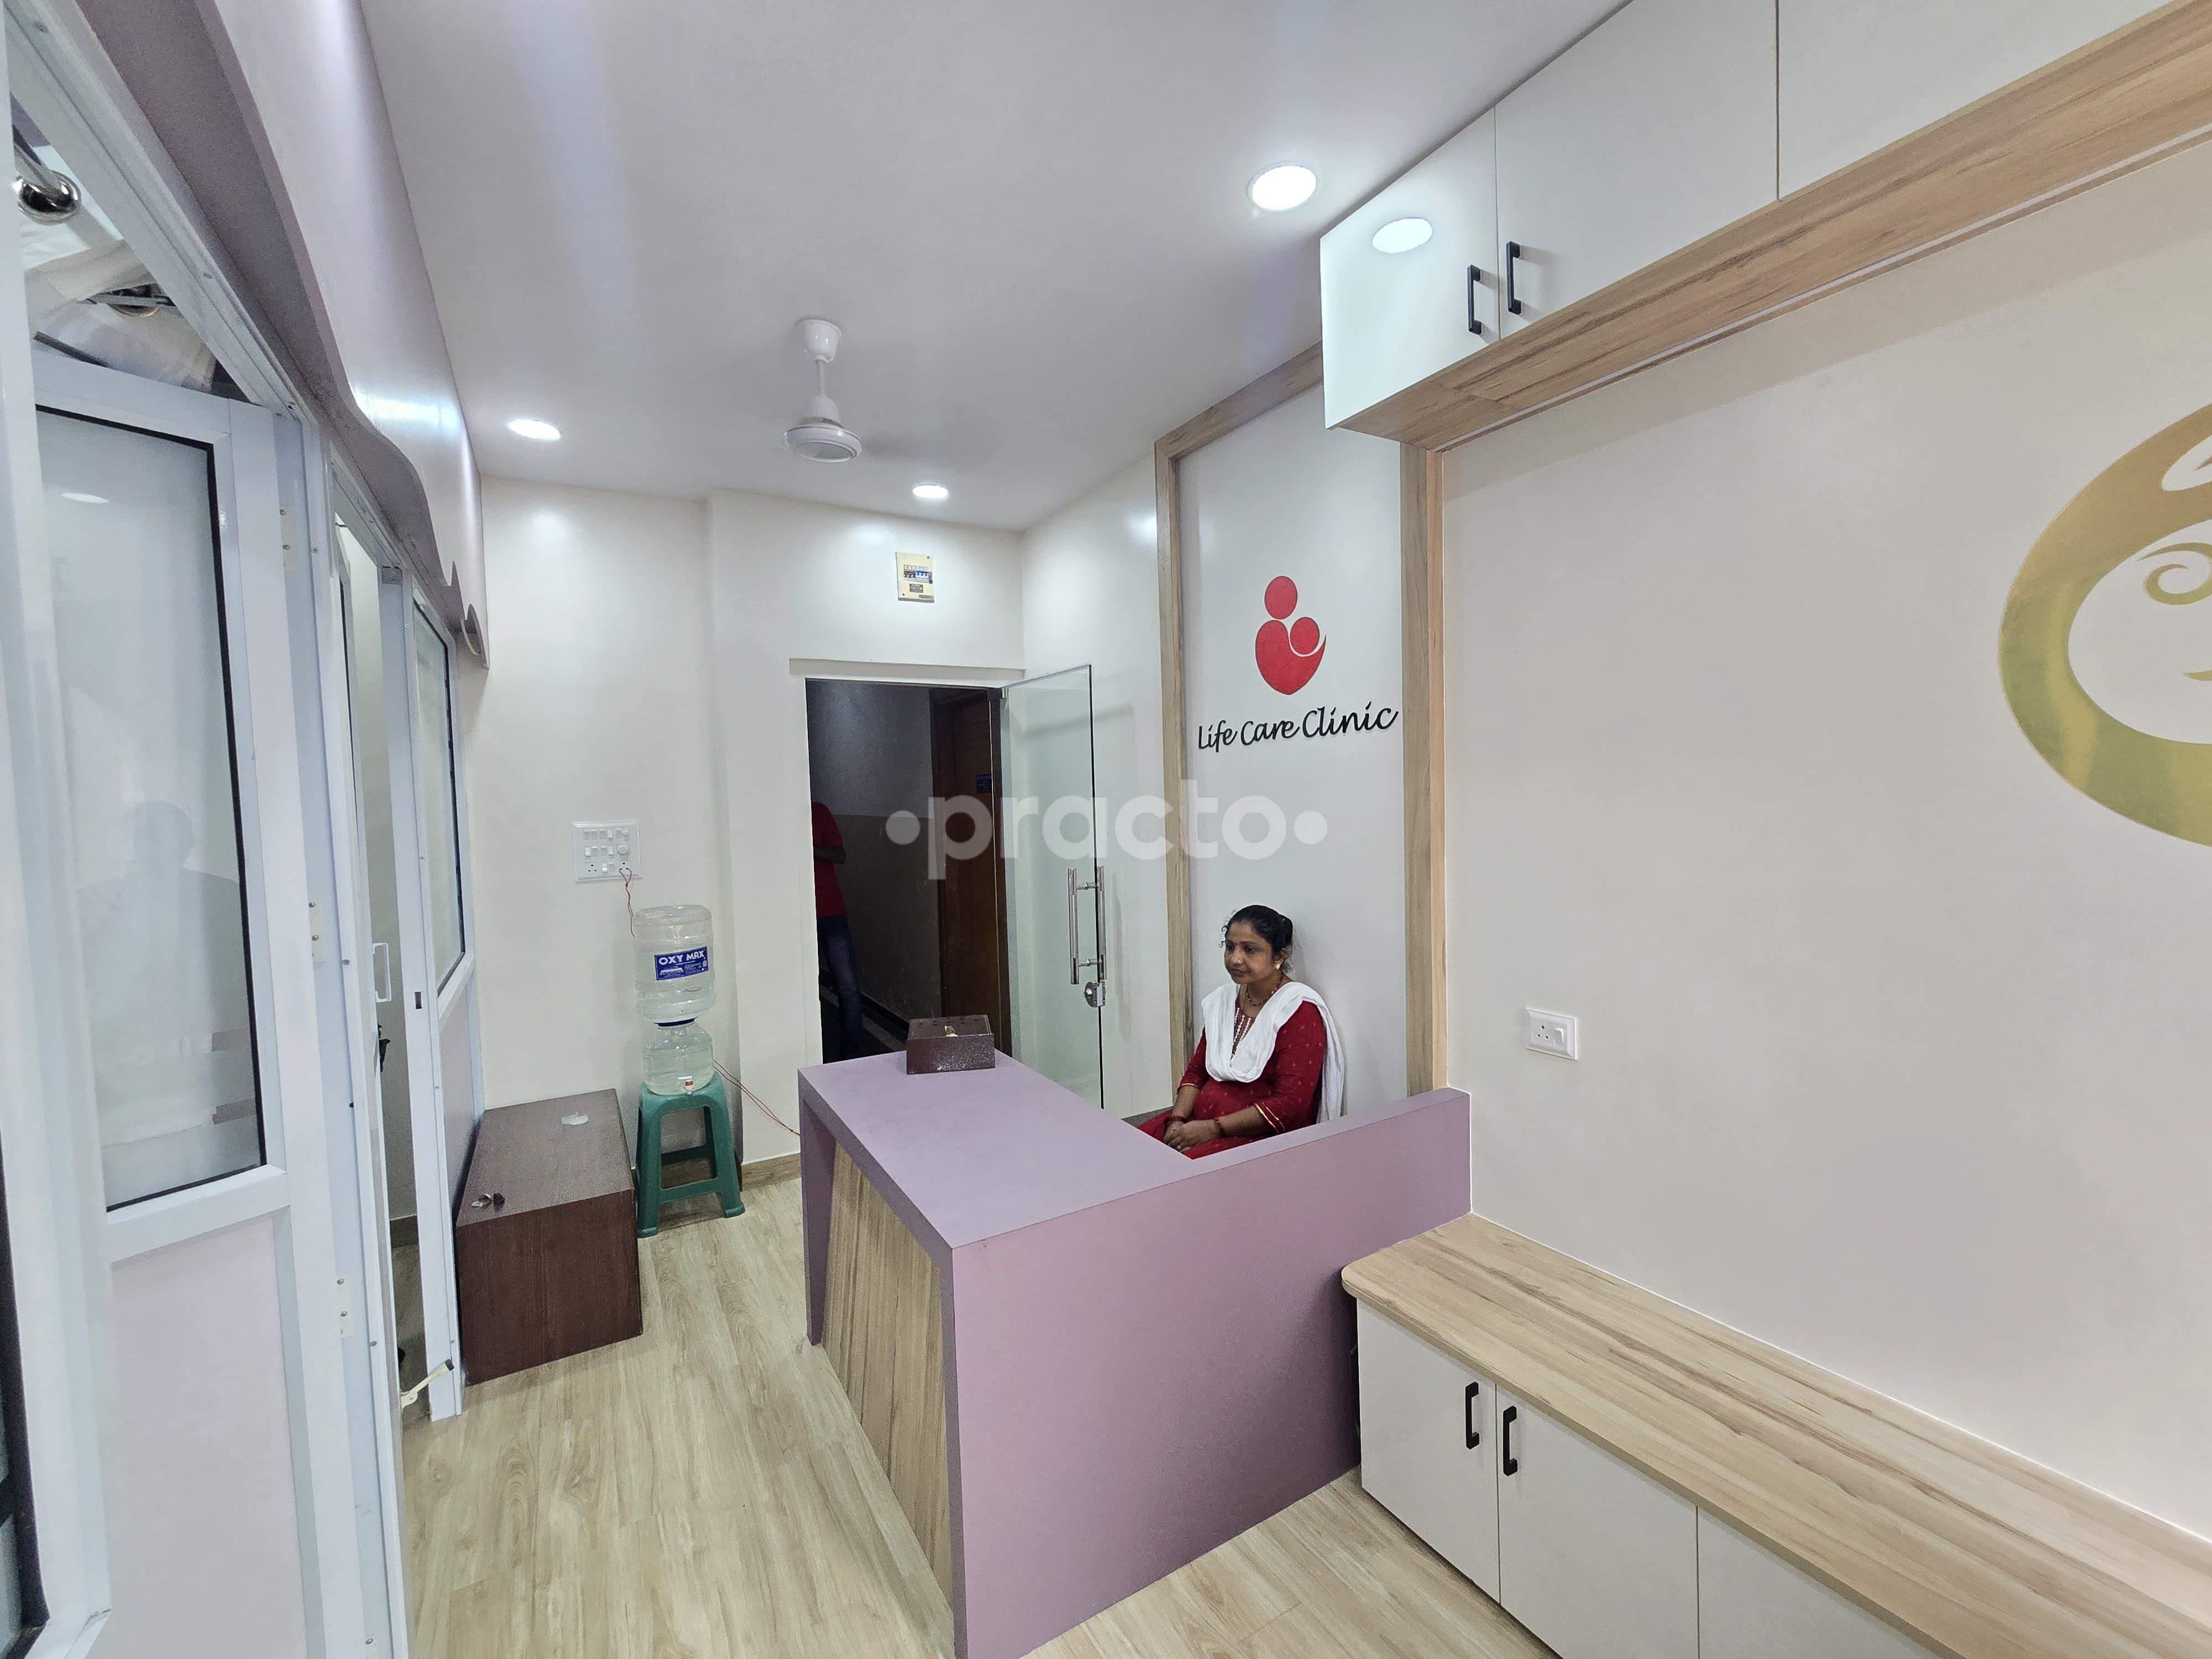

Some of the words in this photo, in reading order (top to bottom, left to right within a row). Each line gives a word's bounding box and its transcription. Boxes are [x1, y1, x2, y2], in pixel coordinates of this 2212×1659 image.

[1198, 720, 1238, 753] Life
[1240, 721, 1300, 745] Care
[1302, 701, 1399, 738] Clinic
[658, 954, 684, 965] OXY
[686, 950, 705, 961] MAX
